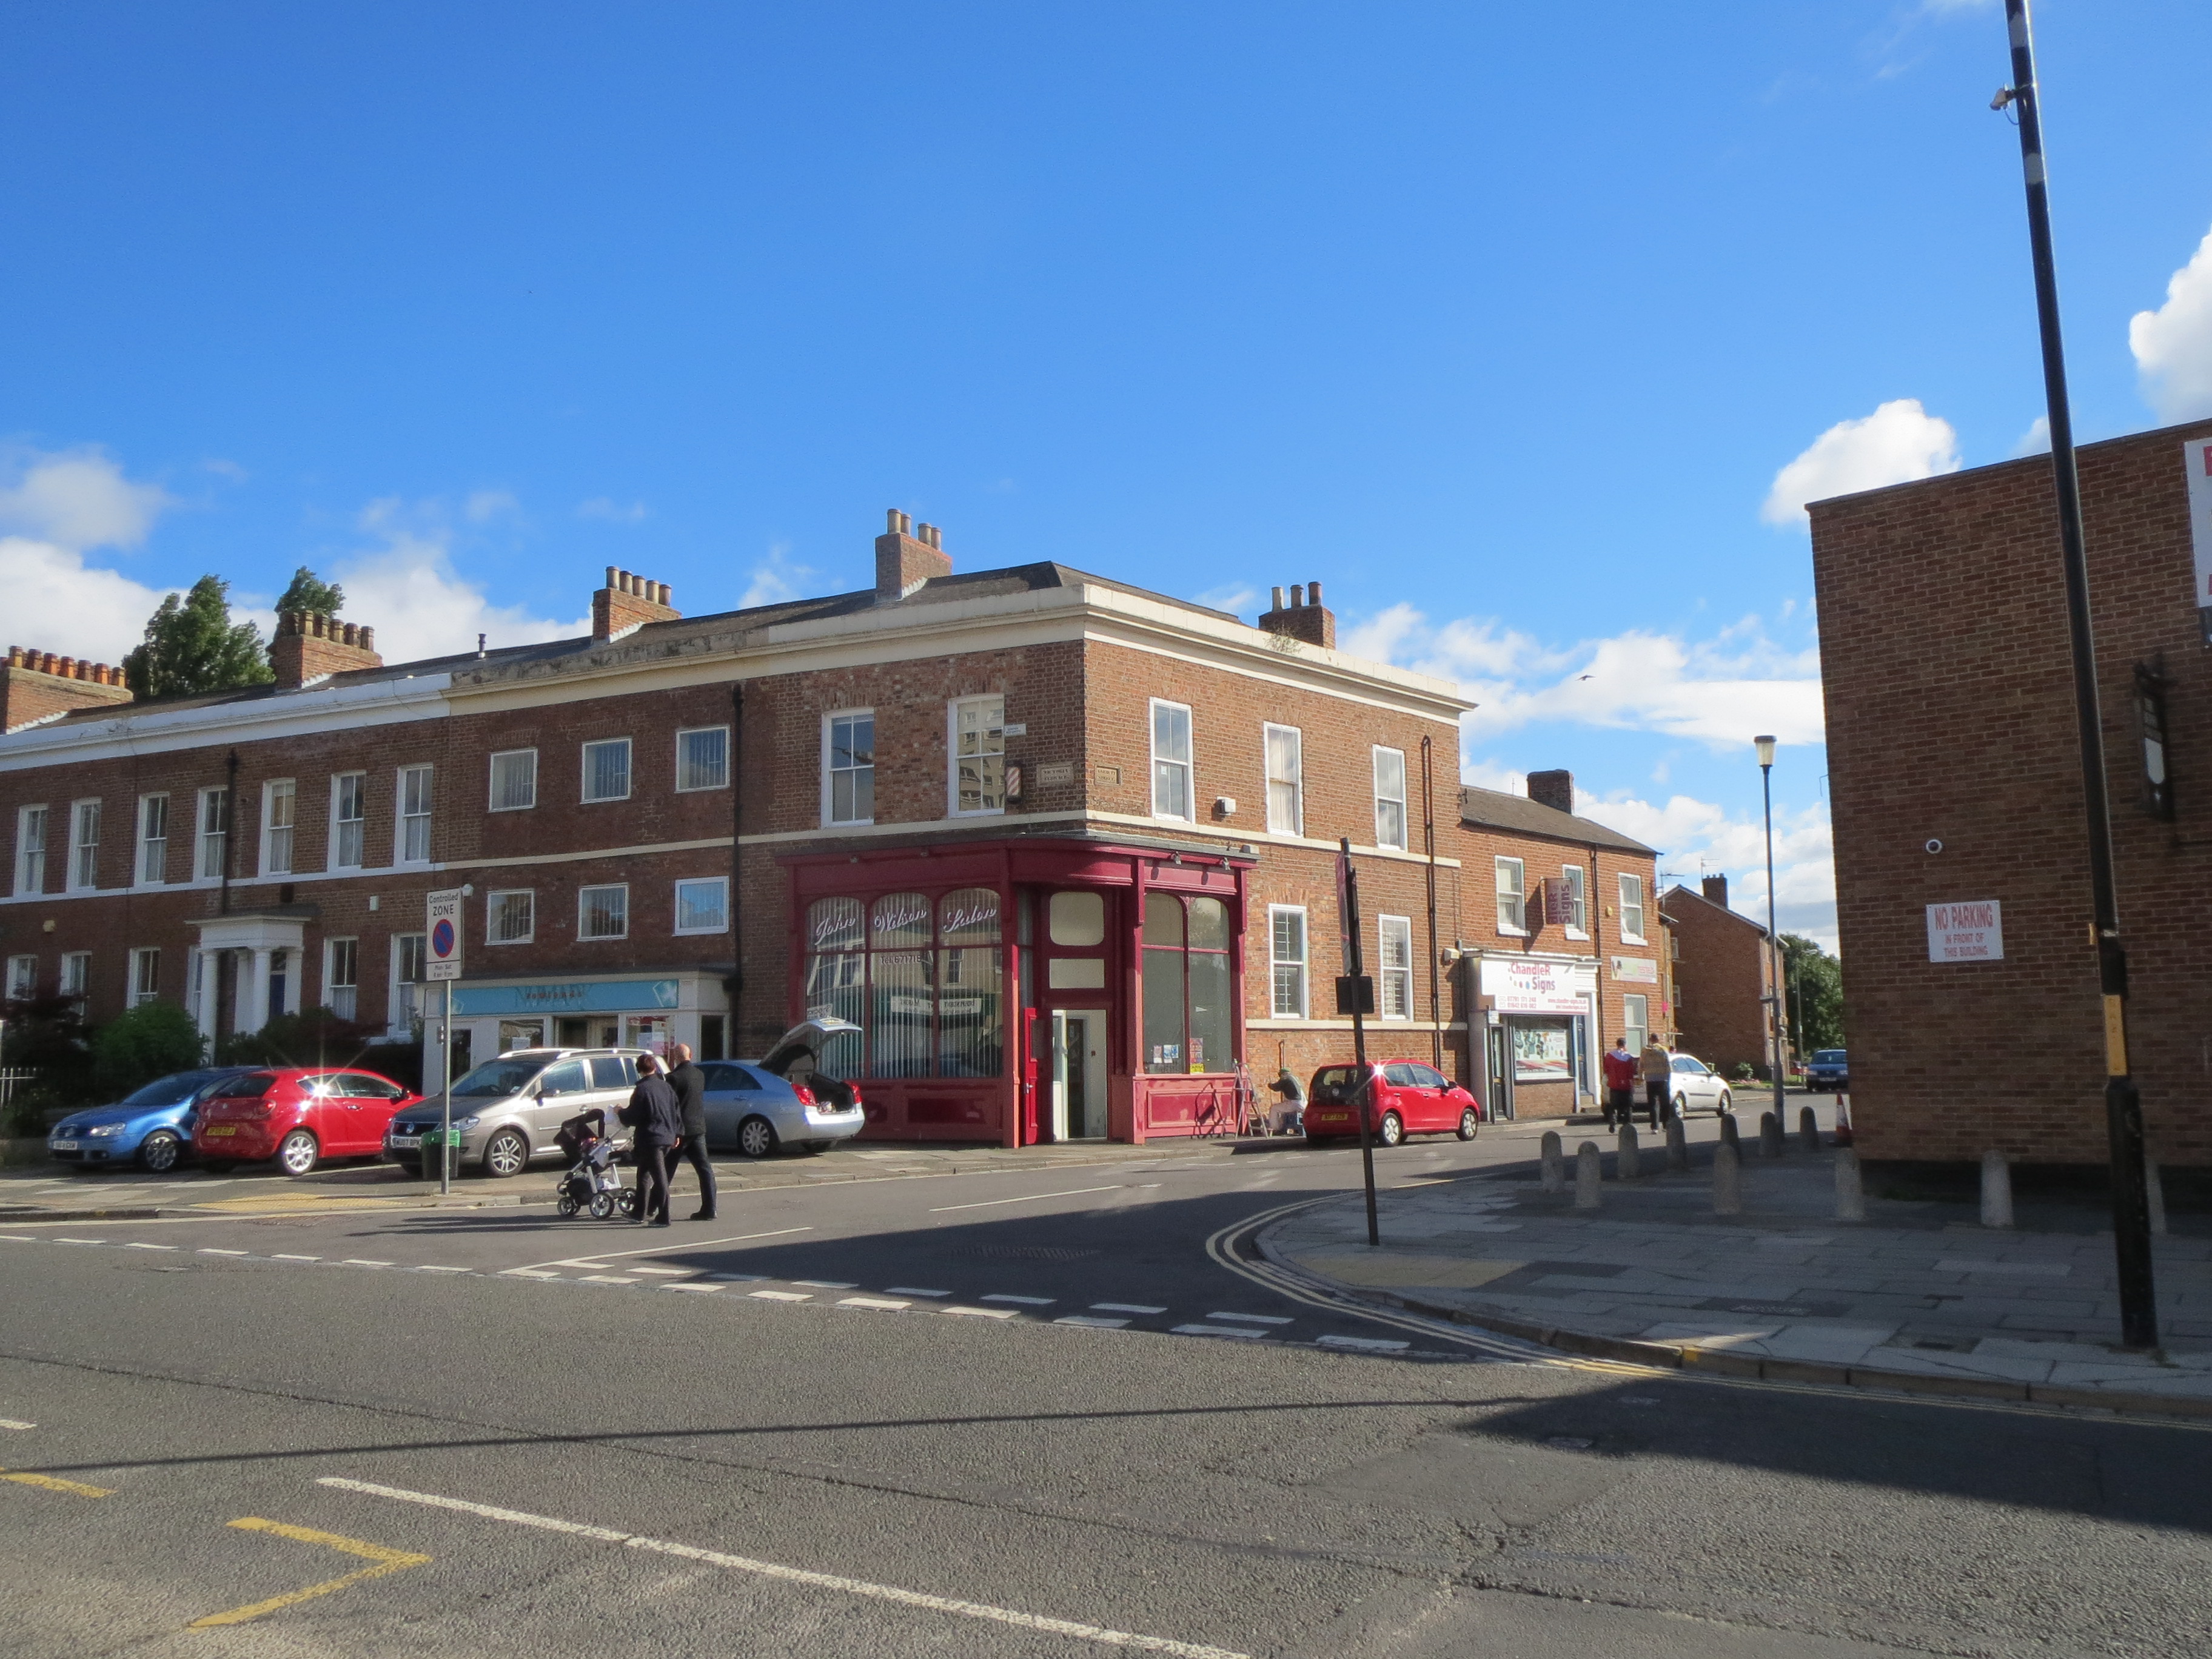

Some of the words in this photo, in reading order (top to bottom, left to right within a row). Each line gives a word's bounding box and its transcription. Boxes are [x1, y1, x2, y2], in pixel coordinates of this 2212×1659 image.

[428, 893, 458, 903] Controlled
[433, 904, 454, 916] ZONE
[1935, 907, 1948, 930] NO
[1951, 903, 1993, 929] PARKING
[815, 914, 856, 945] John
[874, 907, 927, 934] Wilson
[943, 905, 997, 933] Salon
[1945, 934, 1952, 944] IN
[1953, 933, 1973, 943] FRONT
[1976, 933, 1985, 942] OF
[1944, 947, 1957, 957] THIS
[1959, 946, 1988, 956] BUILDING
[1511, 962, 1550, 976] ChandleR
[1532, 976, 1556, 994] Signs
